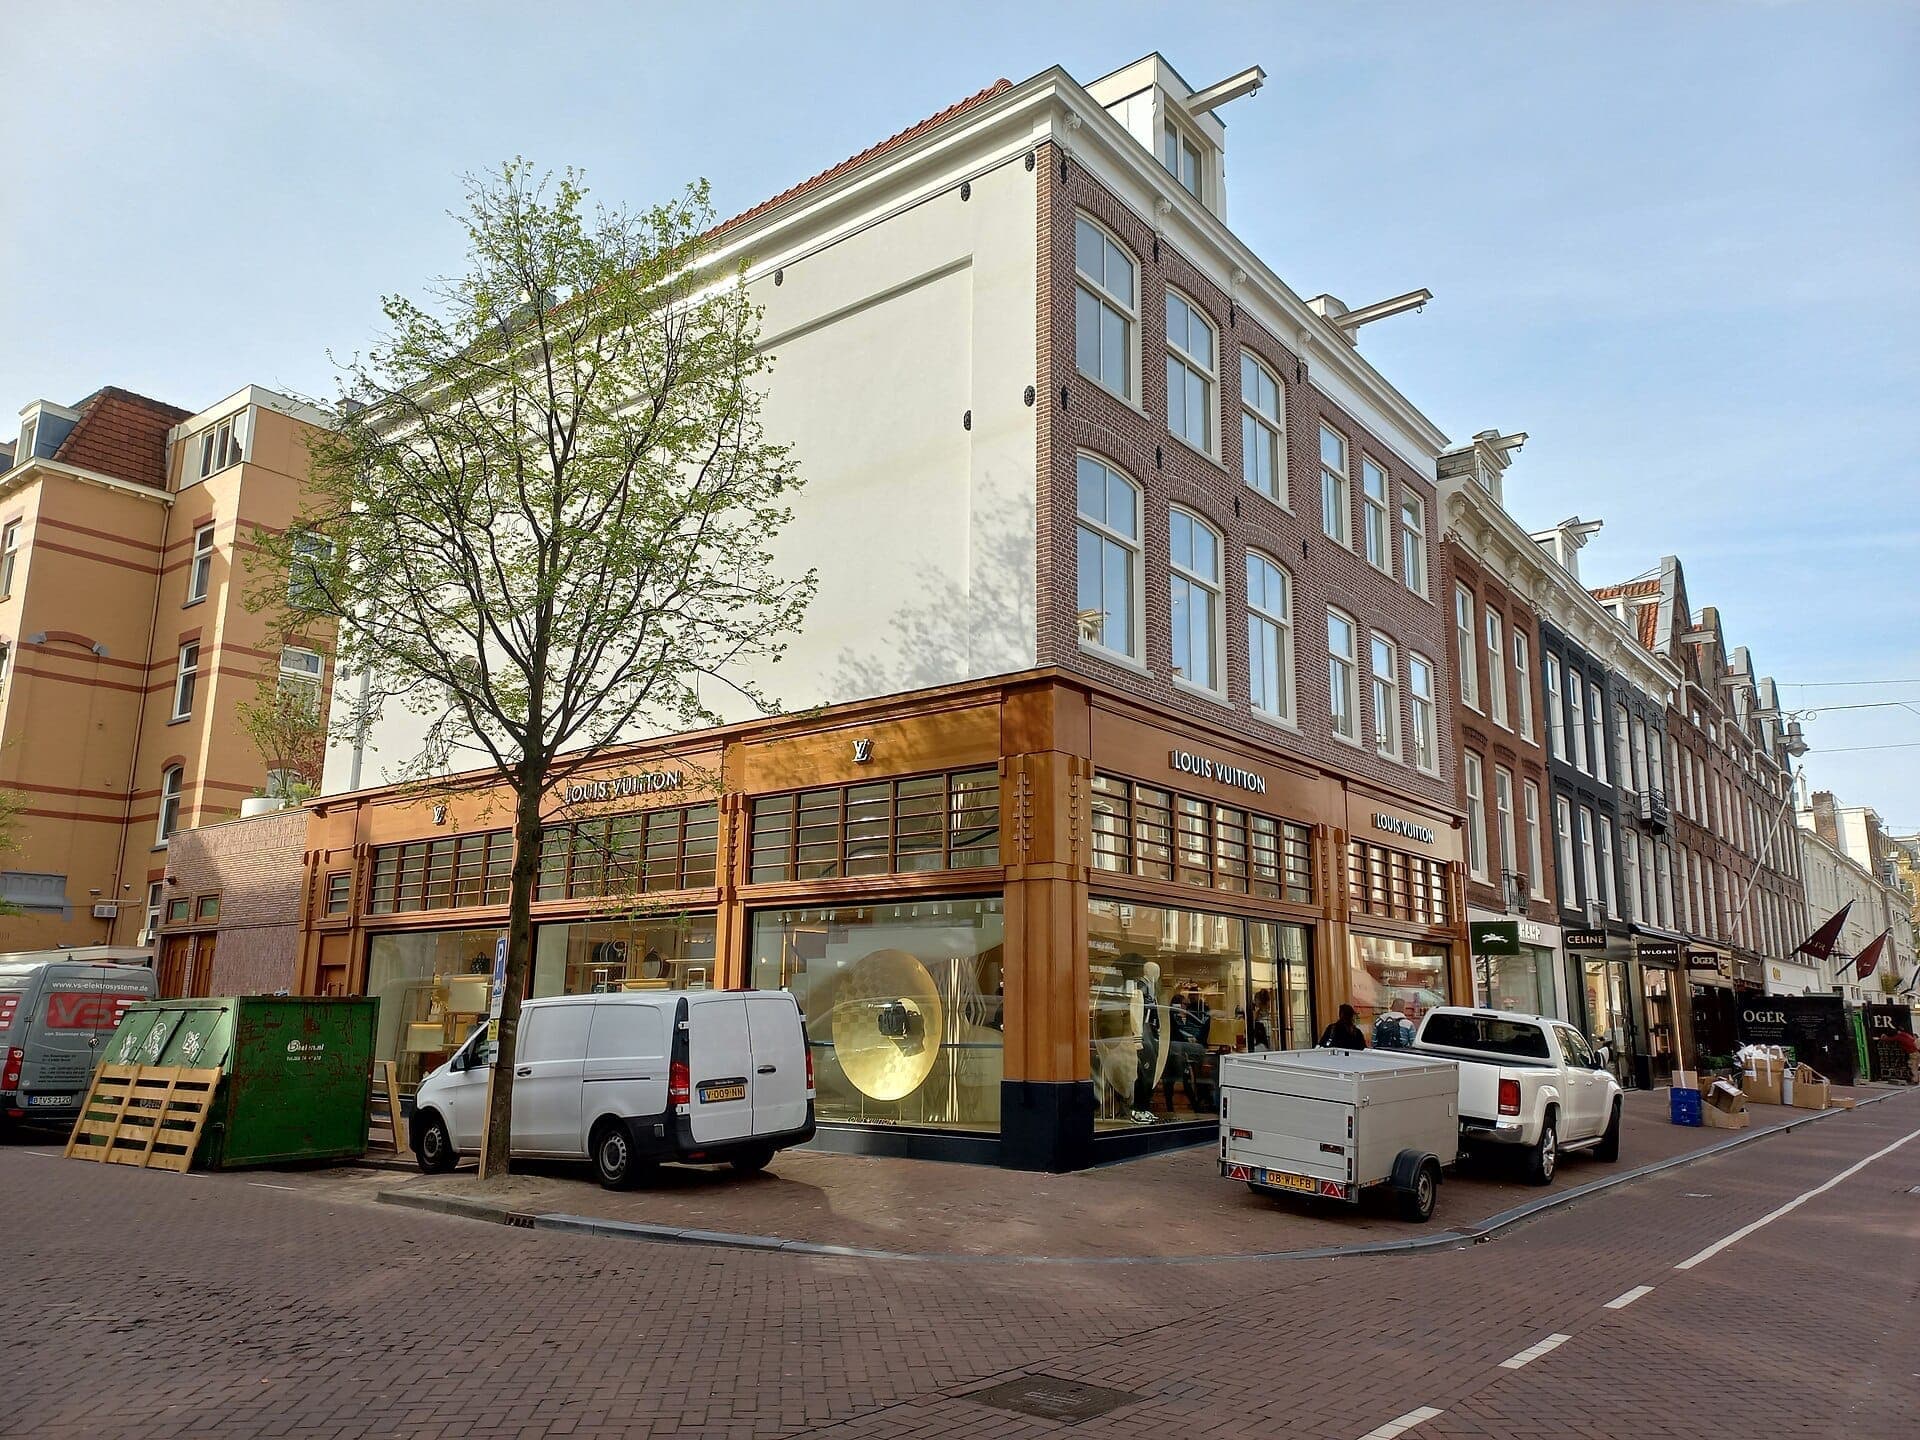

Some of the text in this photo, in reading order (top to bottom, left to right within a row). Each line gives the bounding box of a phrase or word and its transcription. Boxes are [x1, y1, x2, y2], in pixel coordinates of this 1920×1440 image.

[1175, 749, 1266, 795] LOUIS VUITTON
[565, 781, 606, 804] LOUIS
[1376, 812, 1435, 844] LOUIS VUITTON
[1567, 935, 1604, 944] CELINE
[1691, 955, 1717, 966] OGER
[52, 981, 149, 992] www.vs-elektrosysteme.de
[1743, 1010, 1788, 1024] OGER
